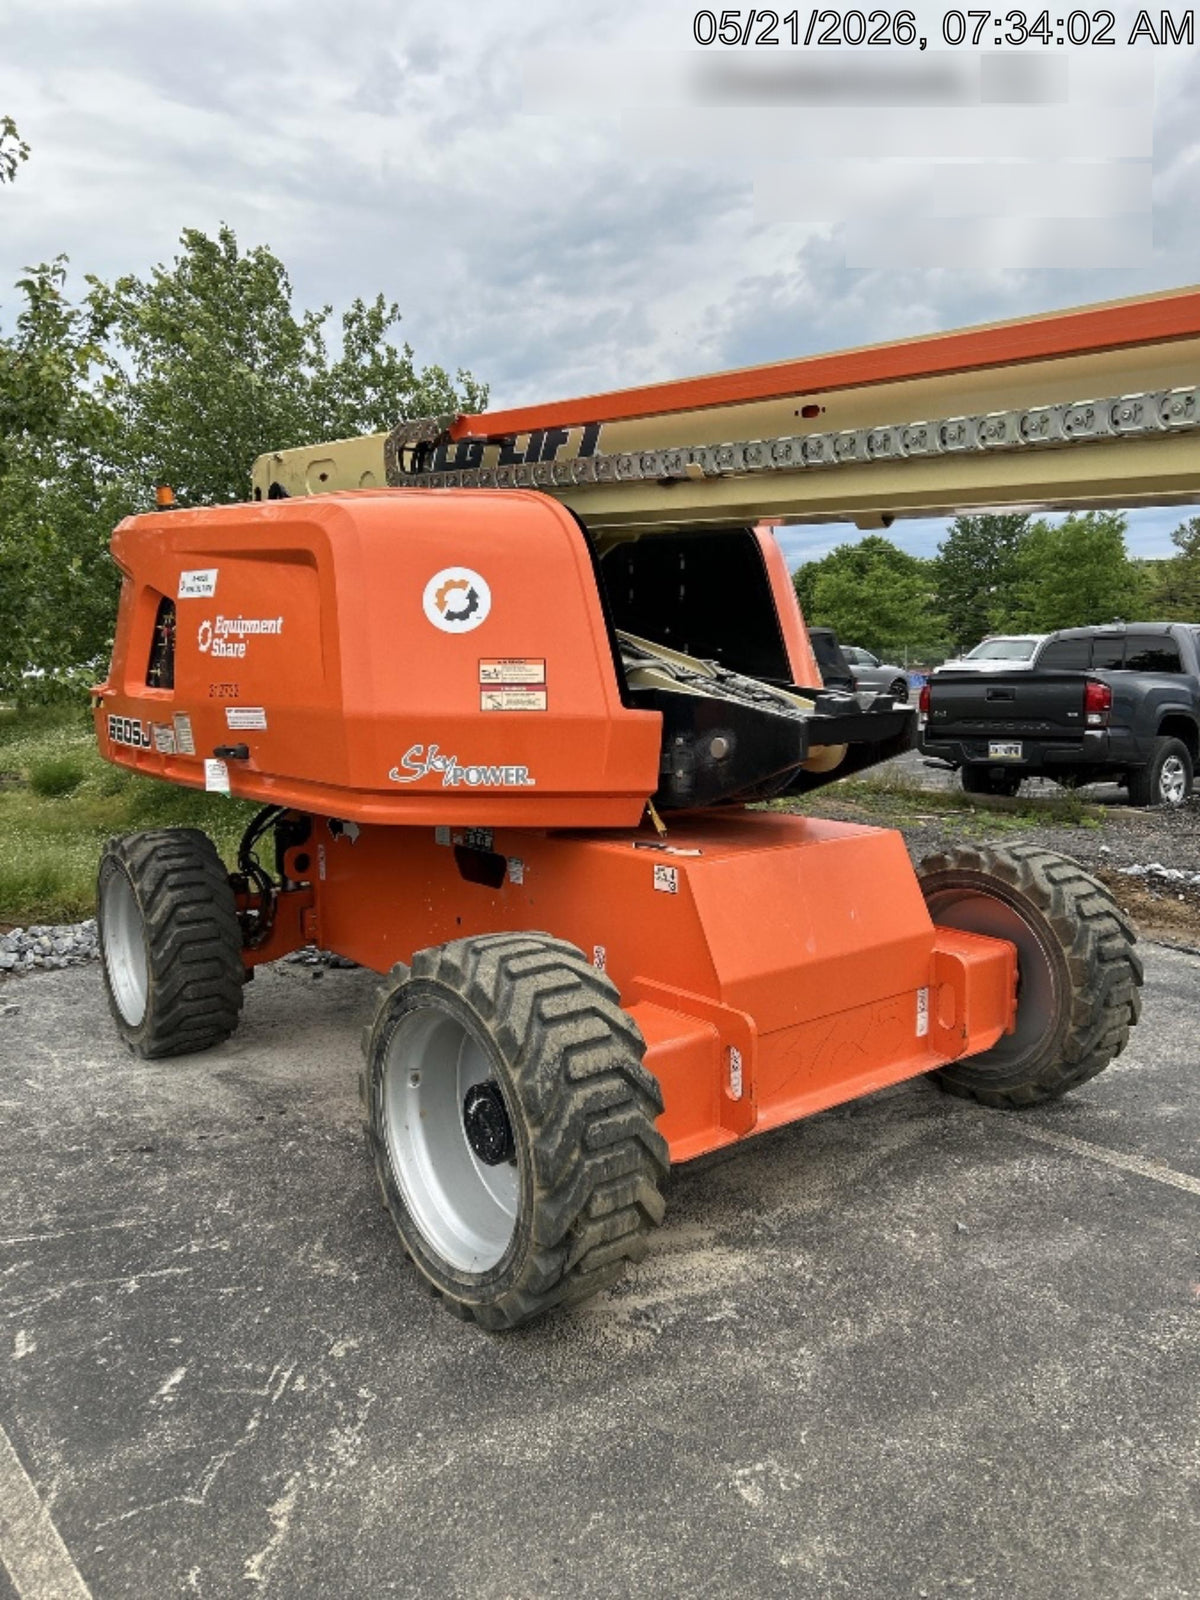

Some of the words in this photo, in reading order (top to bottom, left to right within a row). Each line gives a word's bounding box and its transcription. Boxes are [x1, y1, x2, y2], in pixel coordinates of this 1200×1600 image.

[497, 421, 601, 468] LIFT
[214, 614, 284, 639] Equipment
[211, 637, 247, 659] Share
